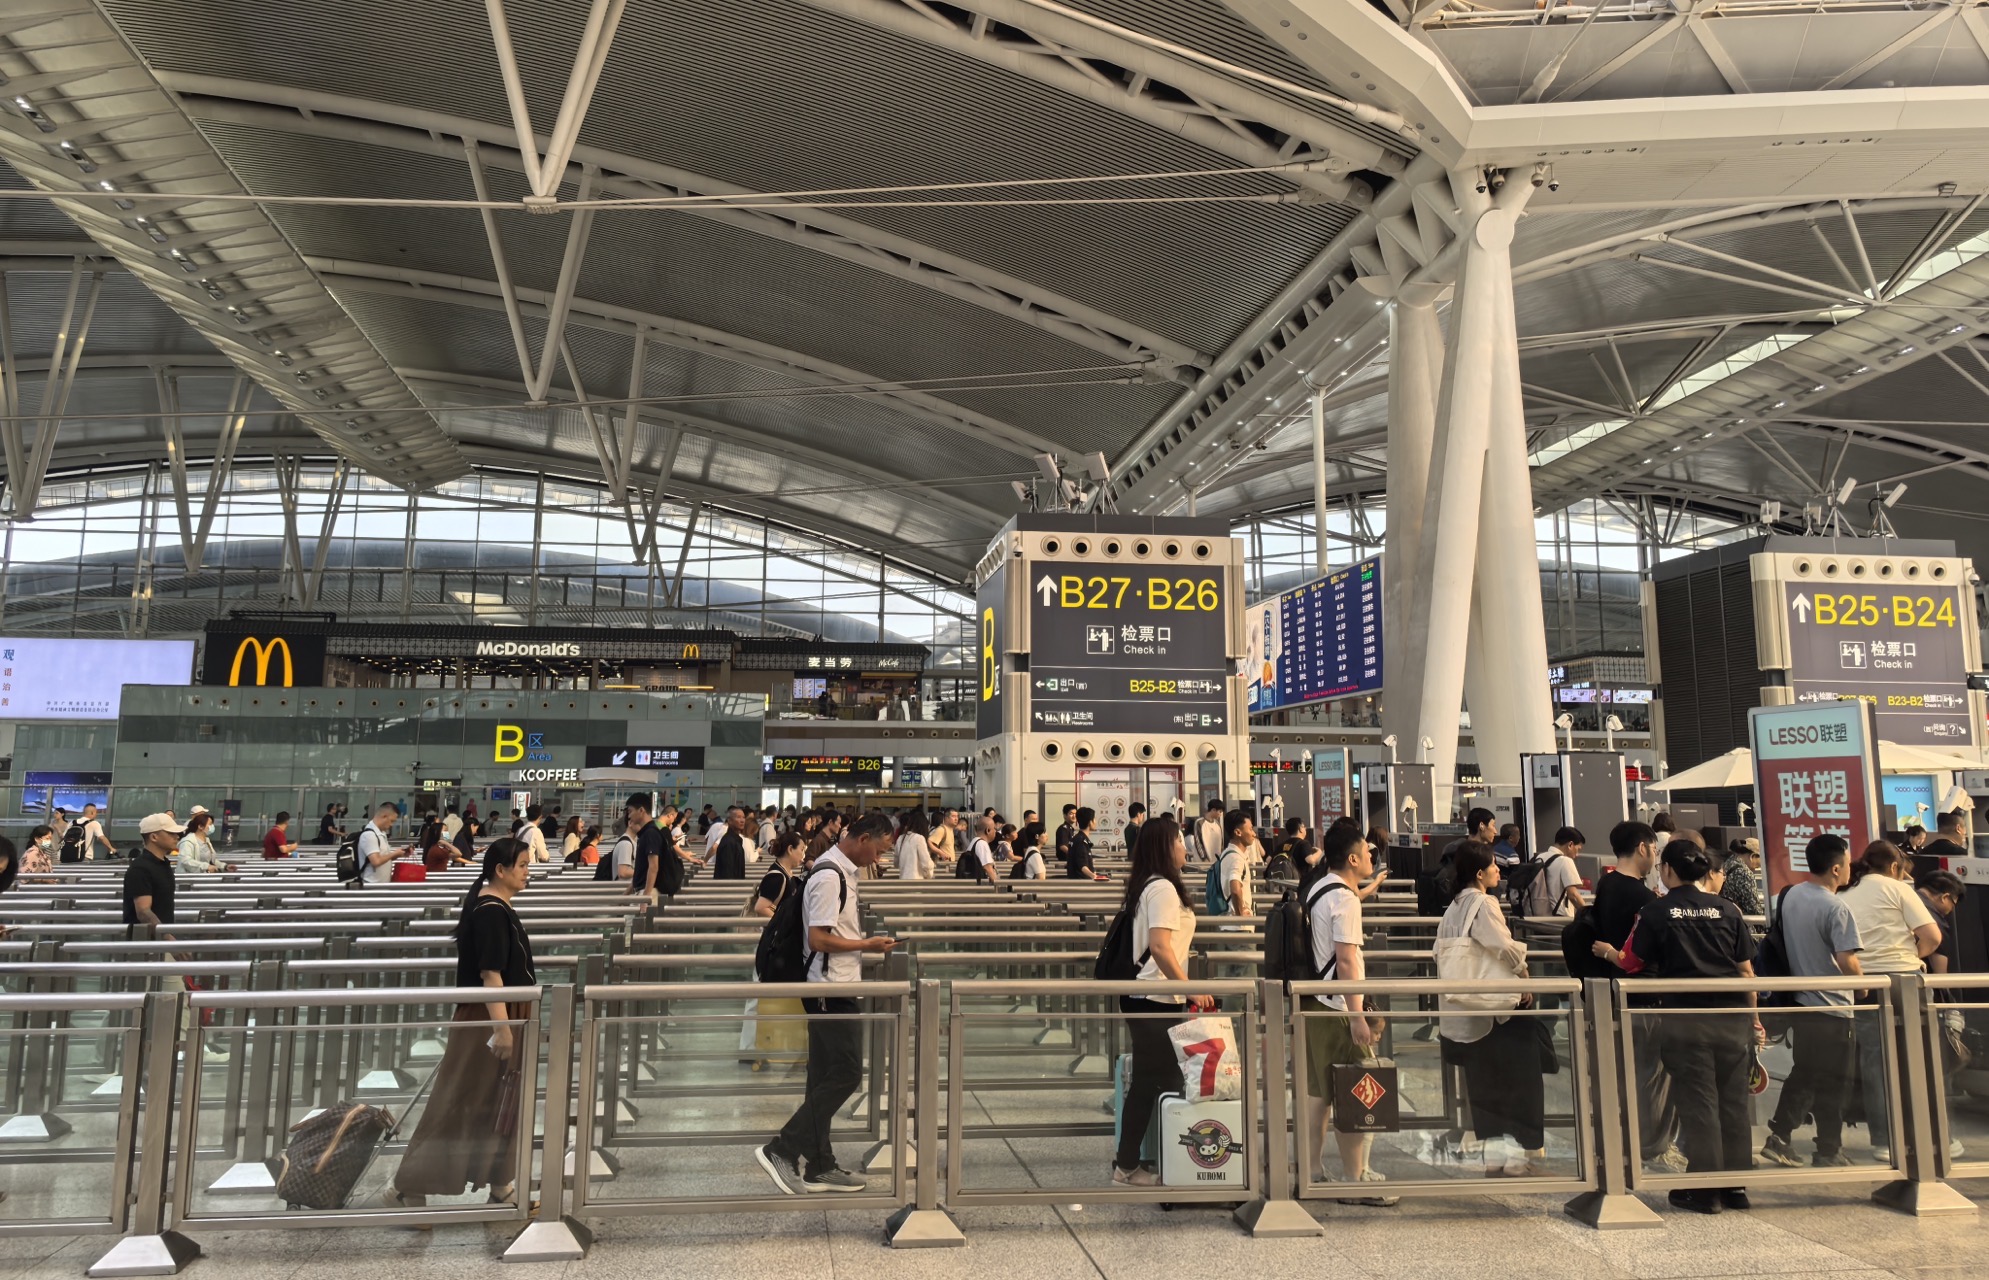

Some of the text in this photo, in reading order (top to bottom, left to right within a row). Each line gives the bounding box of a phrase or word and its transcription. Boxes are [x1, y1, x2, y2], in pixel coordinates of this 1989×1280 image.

[1121, 624, 1171, 642] 检票口
[476, 641, 581, 656] McDonald's
[983, 606, 996, 702] B
[1123, 644, 1167, 655] Check in
[1870, 640, 1916, 657] 检票口
[808, 657, 852, 668] 麦当劳
[1874, 660, 1913, 669] Check in
[1060, 678, 1075, 687] 出口
[1130, 680, 1176, 693] B25-B2
[1177, 680, 1199, 689] 检票口
[1072, 711, 1094, 720] 卫生间
[1184, 713, 1199, 722] 出口
[1769, 725, 1819, 745] LESSO
[1819, 723, 1848, 743] 联塑
[494, 725, 525, 763] B
[528, 733, 544, 749] 区
[527, 752, 553, 762] Area
[652, 750, 680, 760] 卫生间
[775, 759, 799, 771] B27
[857, 759, 881, 771] B26
[518, 768, 578, 782] KCOFFEE
[1320, 785, 1342, 812] 联塑
[1777, 770, 1851, 819] 联塑
[1182, 1038, 1227, 1097] 7
[1196, 1171, 1226, 1181] KUROMI
